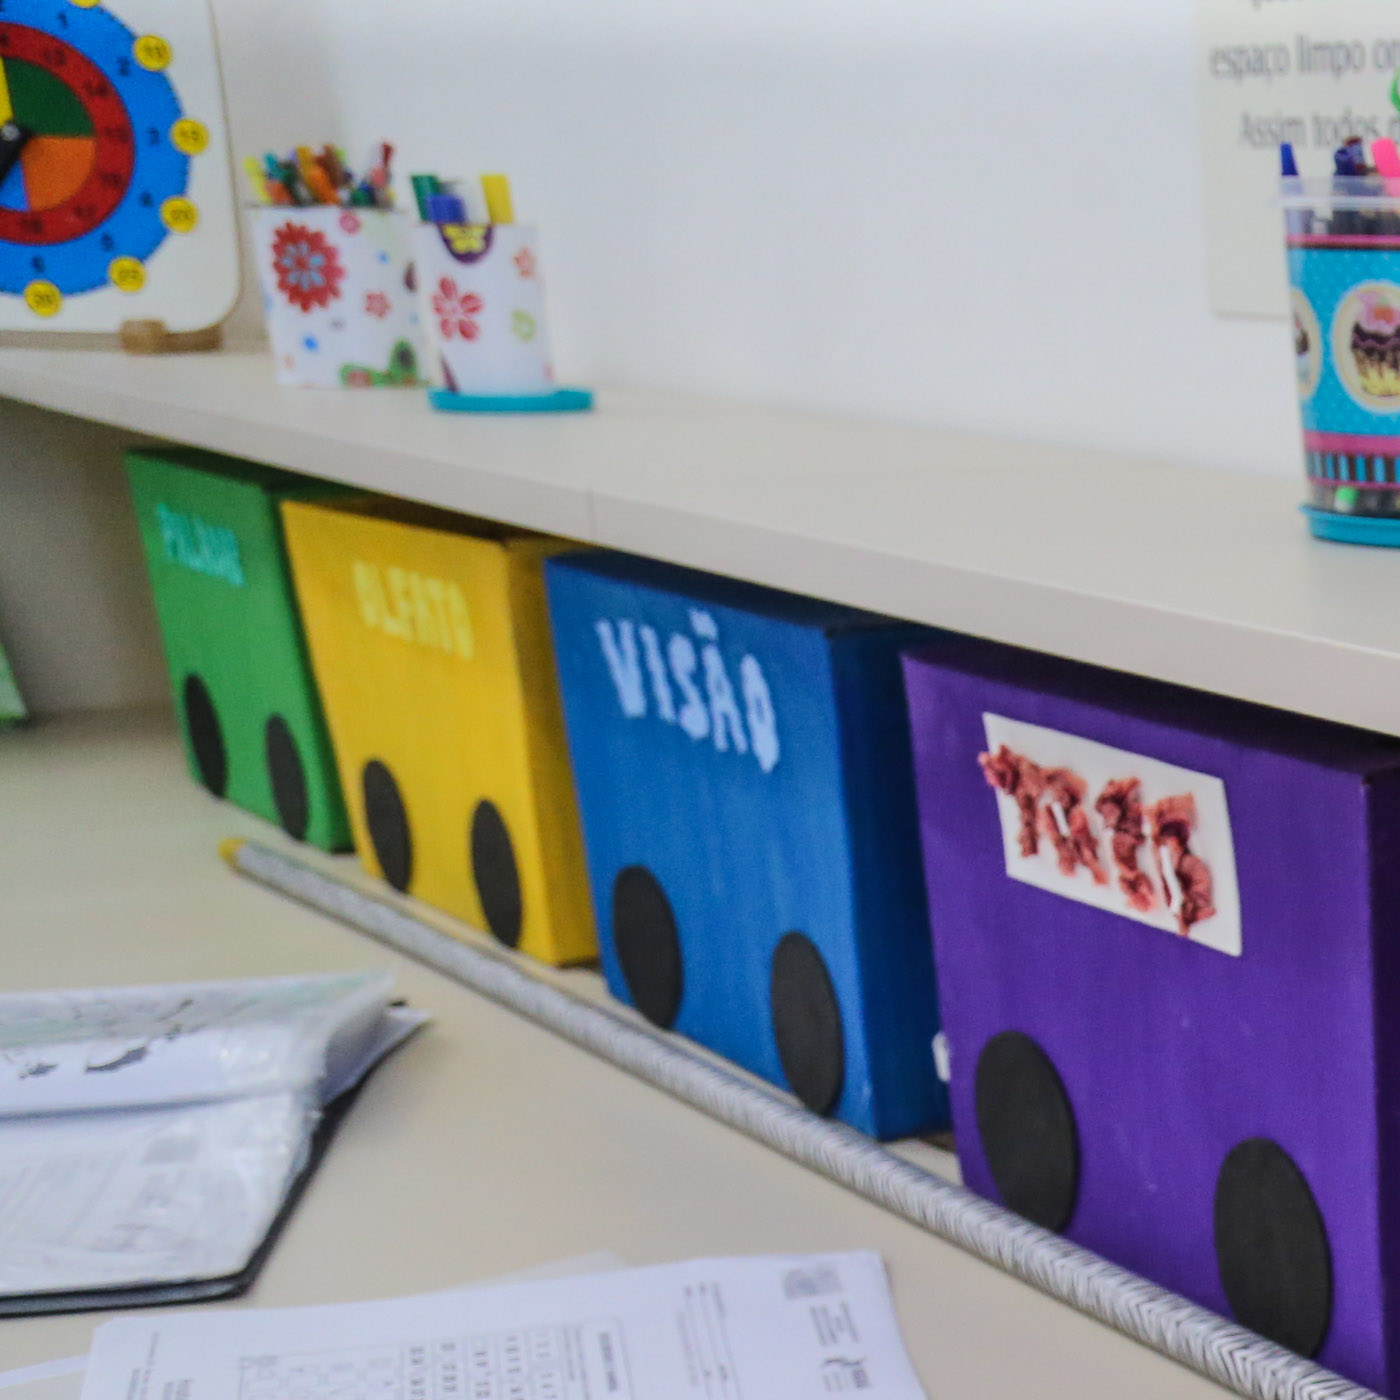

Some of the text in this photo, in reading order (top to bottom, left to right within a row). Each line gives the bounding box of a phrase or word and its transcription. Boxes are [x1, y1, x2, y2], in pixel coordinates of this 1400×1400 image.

[1209, 40, 1291, 83] espaço
[1294, 31, 1367, 84] limpo
[1239, 109, 1307, 147] Assim
[594, 606, 781, 774] VISÃO
